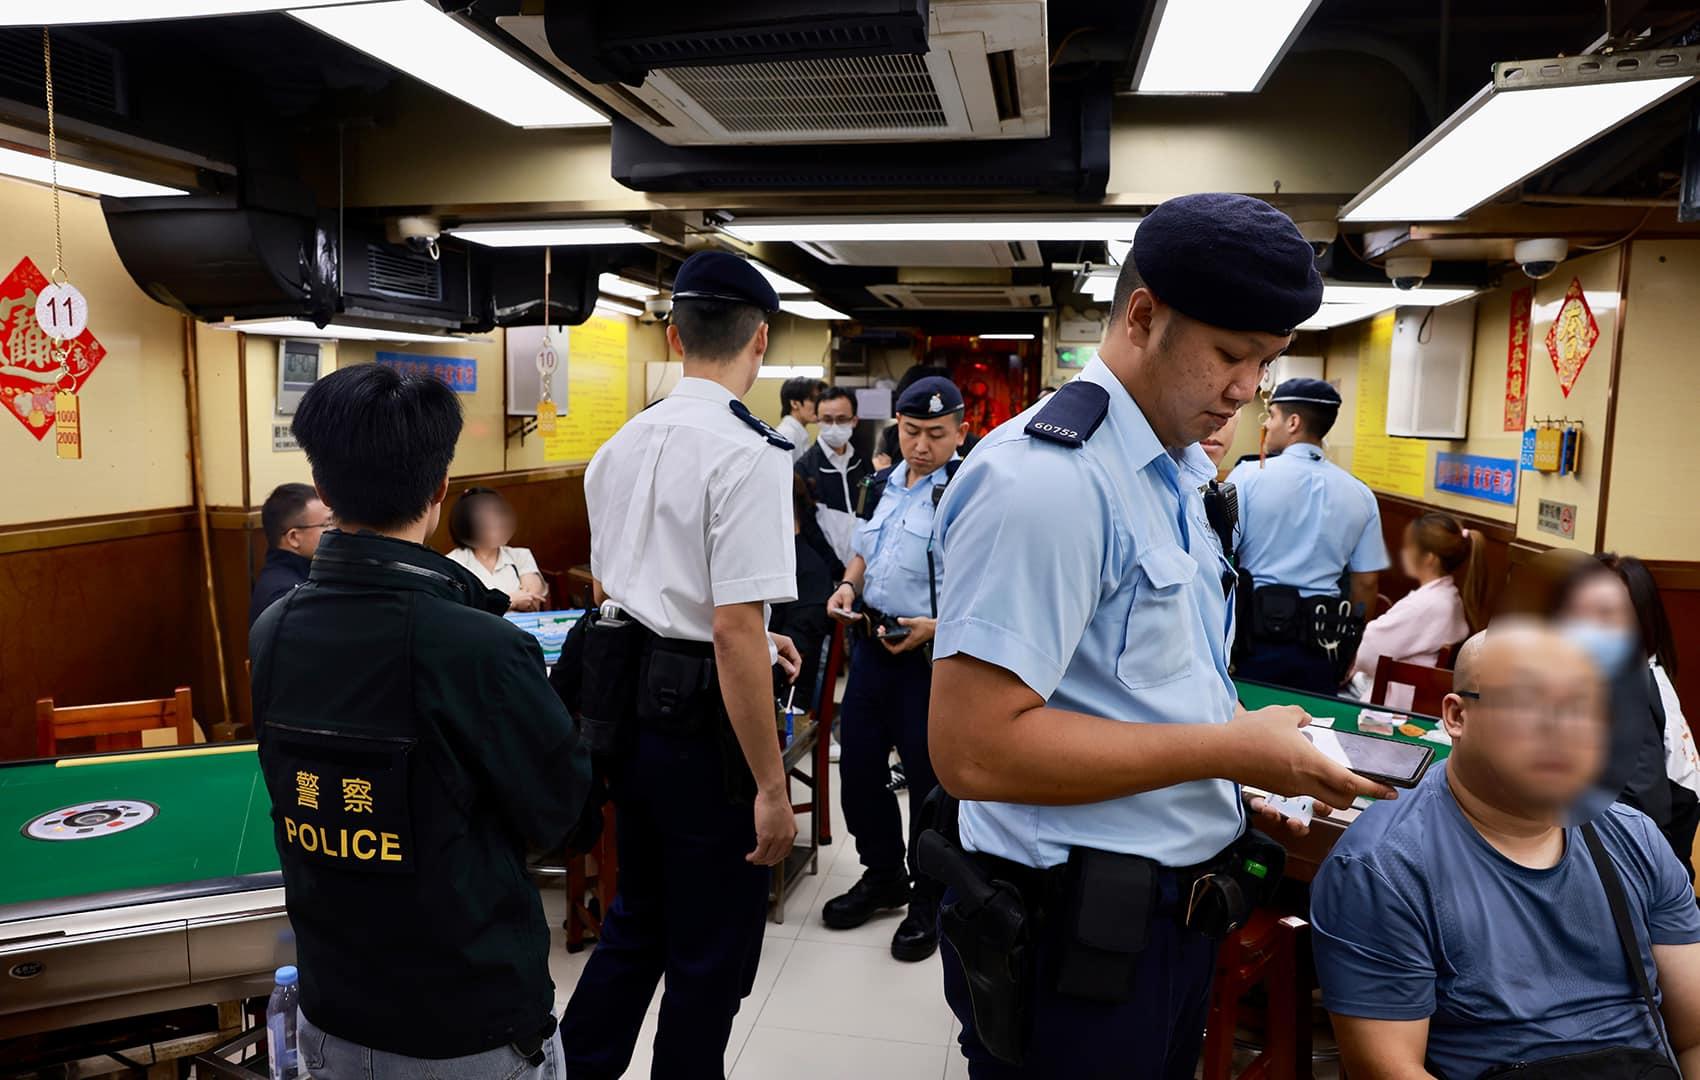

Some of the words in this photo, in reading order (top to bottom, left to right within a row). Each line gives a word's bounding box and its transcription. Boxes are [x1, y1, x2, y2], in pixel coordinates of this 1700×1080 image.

[46, 297, 73, 327] 11
[539, 351, 554, 368] 10
[57, 411, 77, 424] 1000
[57, 432, 77, 445] 2000
[1034, 422, 1079, 439] 60752
[296, 771, 374, 814] 警察
[284, 816, 402, 862] POLICE
